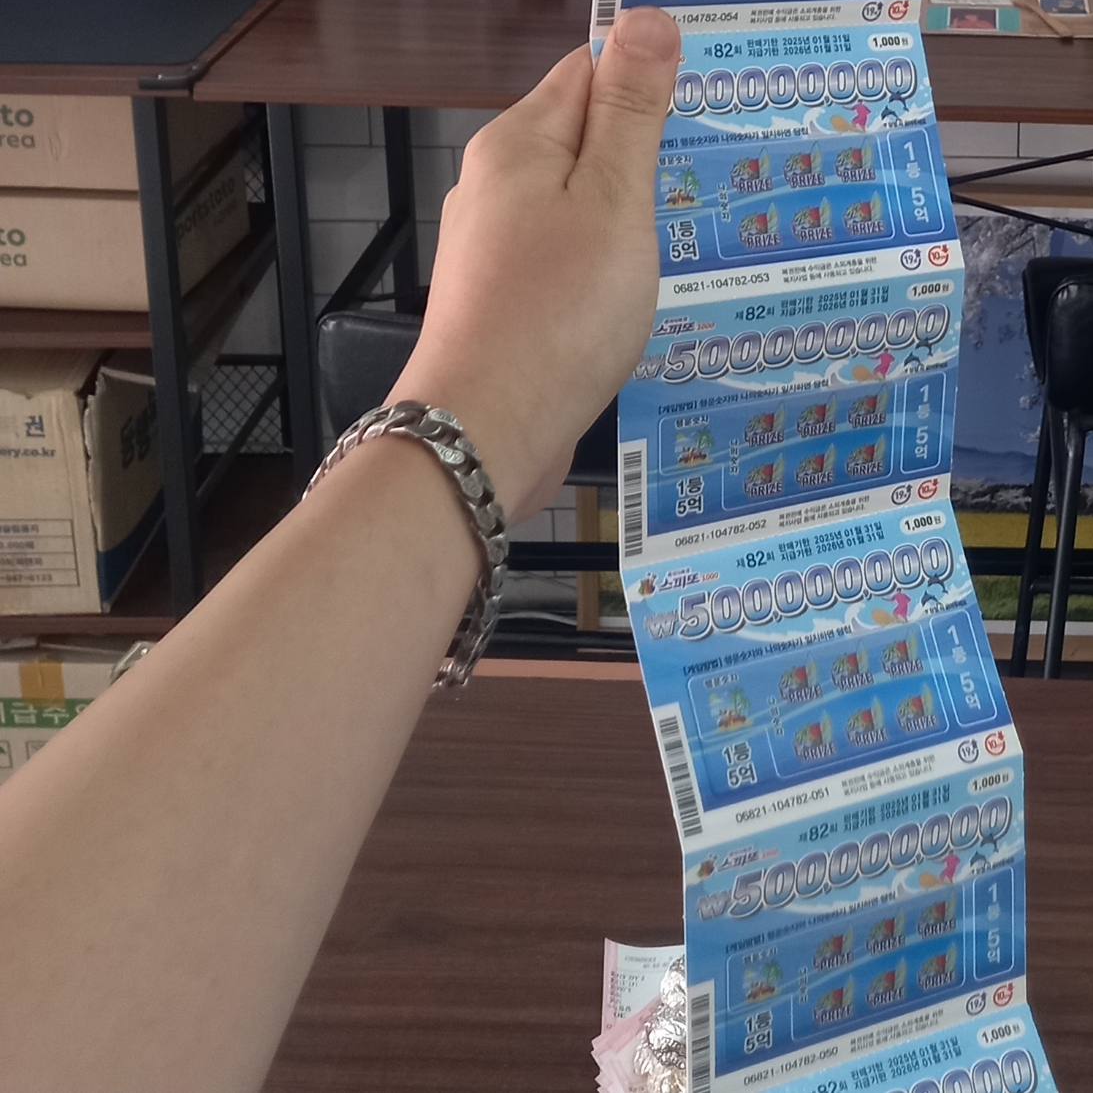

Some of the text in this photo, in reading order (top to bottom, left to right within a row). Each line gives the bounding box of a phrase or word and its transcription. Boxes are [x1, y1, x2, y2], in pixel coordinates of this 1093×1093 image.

[782, 35, 811, 47] 2025년
[833, 33, 851, 44] 31일
[667, 220, 697, 241] 1등
[670, 240, 700, 262] 5억
[673, 272, 771, 295] 06821-104782-053
[26, 415, 46, 438] 권
[676, 475, 705, 498] 1등
[675, 495, 704, 518] 5억
[675, 518, 767, 548] 06821-104782-052
[904, 515, 942, 532] 1,000원
[722, 740, 753, 766] 1등
[726, 762, 758, 789] 5억
[735, 786, 831, 824] 06821-104782-051
[745, 1008, 774, 1035] 1등
[743, 1028, 773, 1055] 5억
[743, 1045, 839, 1087] 06821-104782-050
